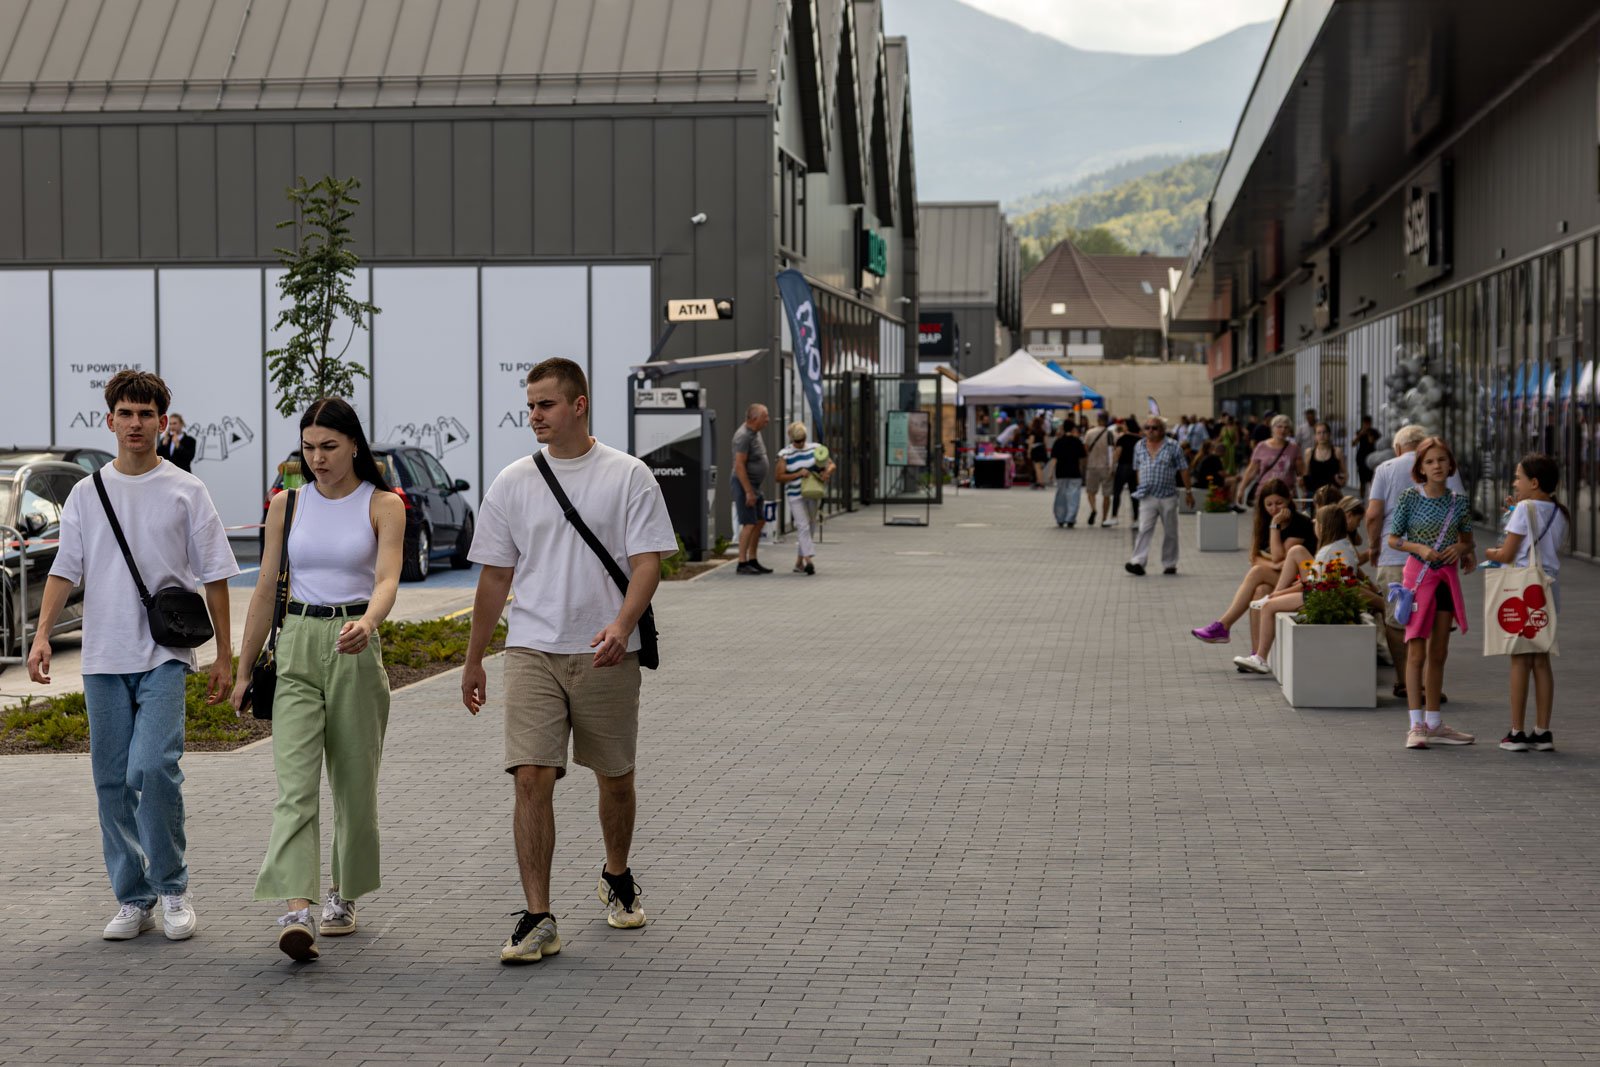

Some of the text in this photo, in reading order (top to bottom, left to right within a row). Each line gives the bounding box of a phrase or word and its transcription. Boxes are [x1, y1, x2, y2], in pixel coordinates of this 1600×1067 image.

[678, 304, 707, 316] ATM
[918, 333, 942, 344] BAP
[71, 363, 83, 373] TU
[499, 362, 513, 372] TU
[90, 379, 107, 389] SKL
[70, 410, 107, 428] AP
[498, 410, 530, 428] AP
